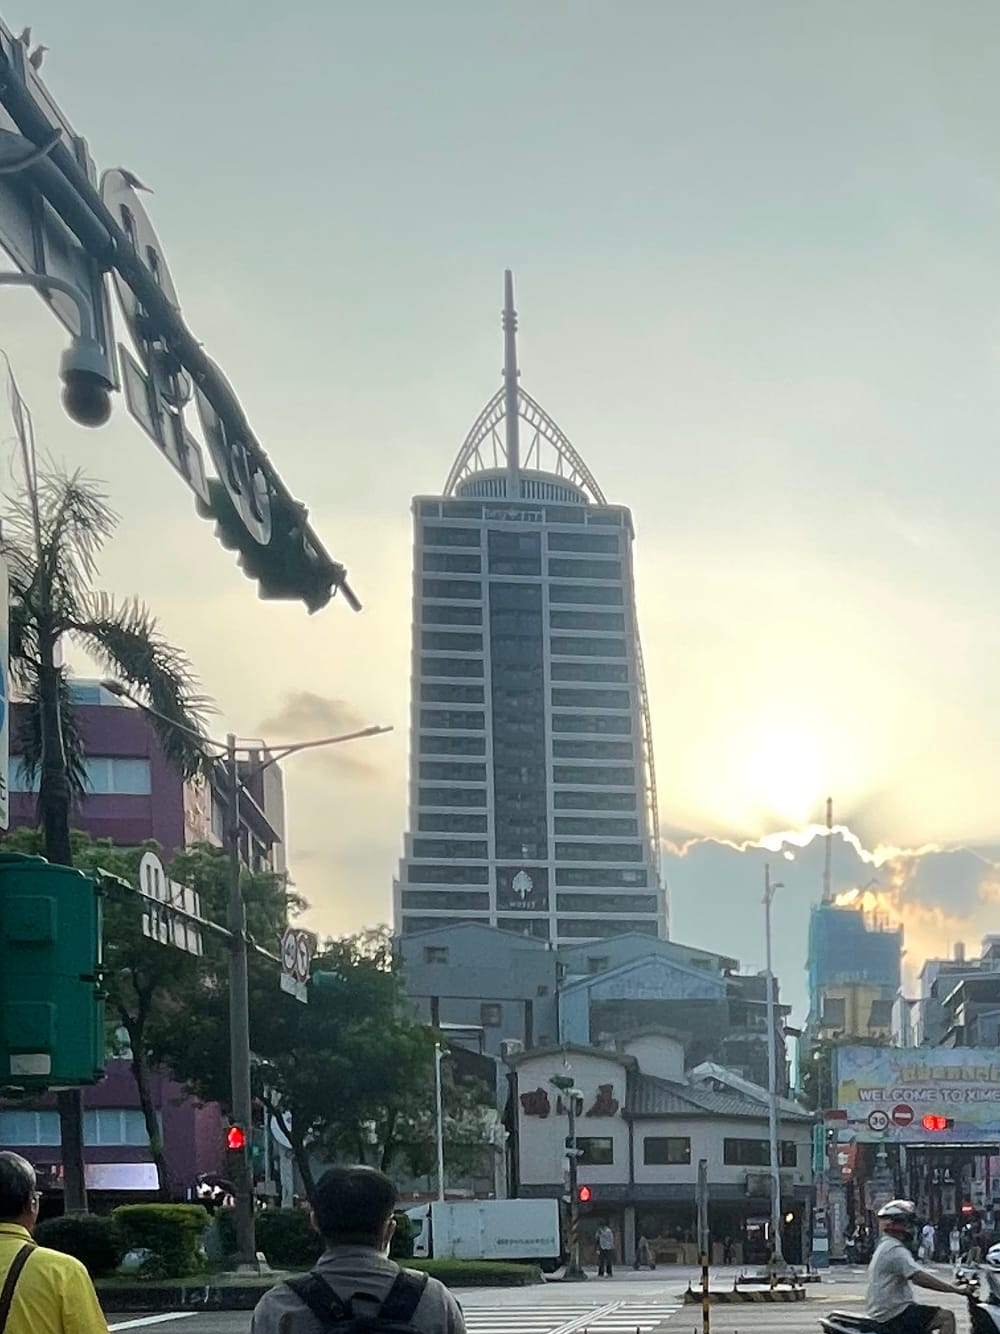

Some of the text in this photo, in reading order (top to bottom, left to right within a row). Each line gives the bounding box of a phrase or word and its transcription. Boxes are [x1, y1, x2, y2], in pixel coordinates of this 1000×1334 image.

[859, 1087, 938, 1101] WELCOME
[942, 1088, 964, 1101] TO
[871, 1116, 886, 1125] 30
